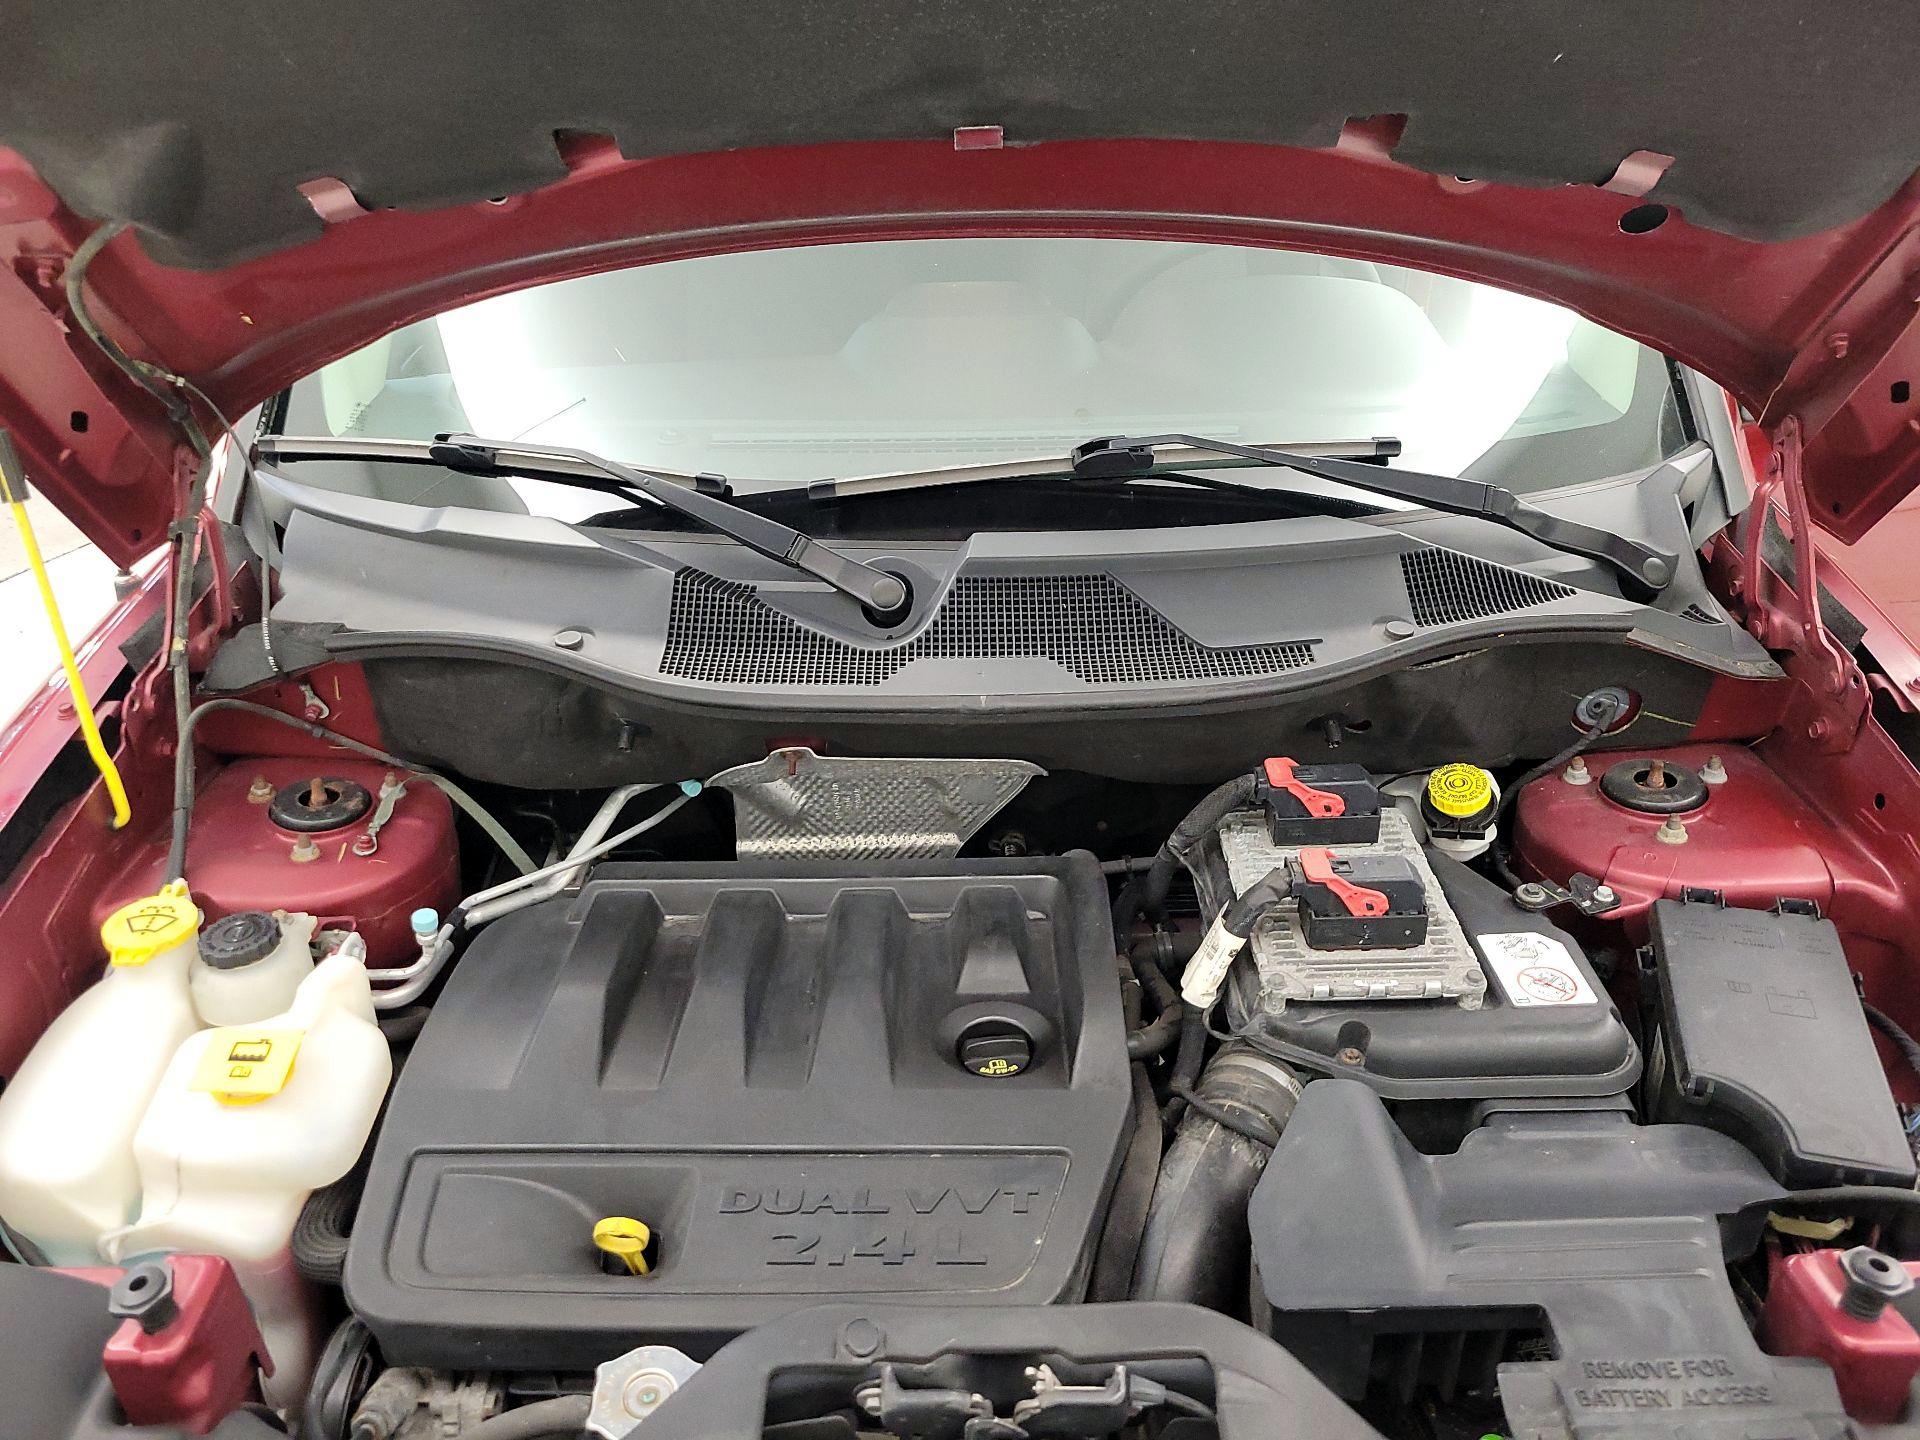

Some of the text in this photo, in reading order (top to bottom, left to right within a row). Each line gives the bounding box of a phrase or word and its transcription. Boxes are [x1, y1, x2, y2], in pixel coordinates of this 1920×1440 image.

[719, 1187, 1040, 1215] DUAL VVT
[766, 1229, 989, 1267] 2.4L
[1581, 1357, 1735, 1381] REMOVE FOR
[1573, 1385, 1773, 1409] BATTERY ACCESS
